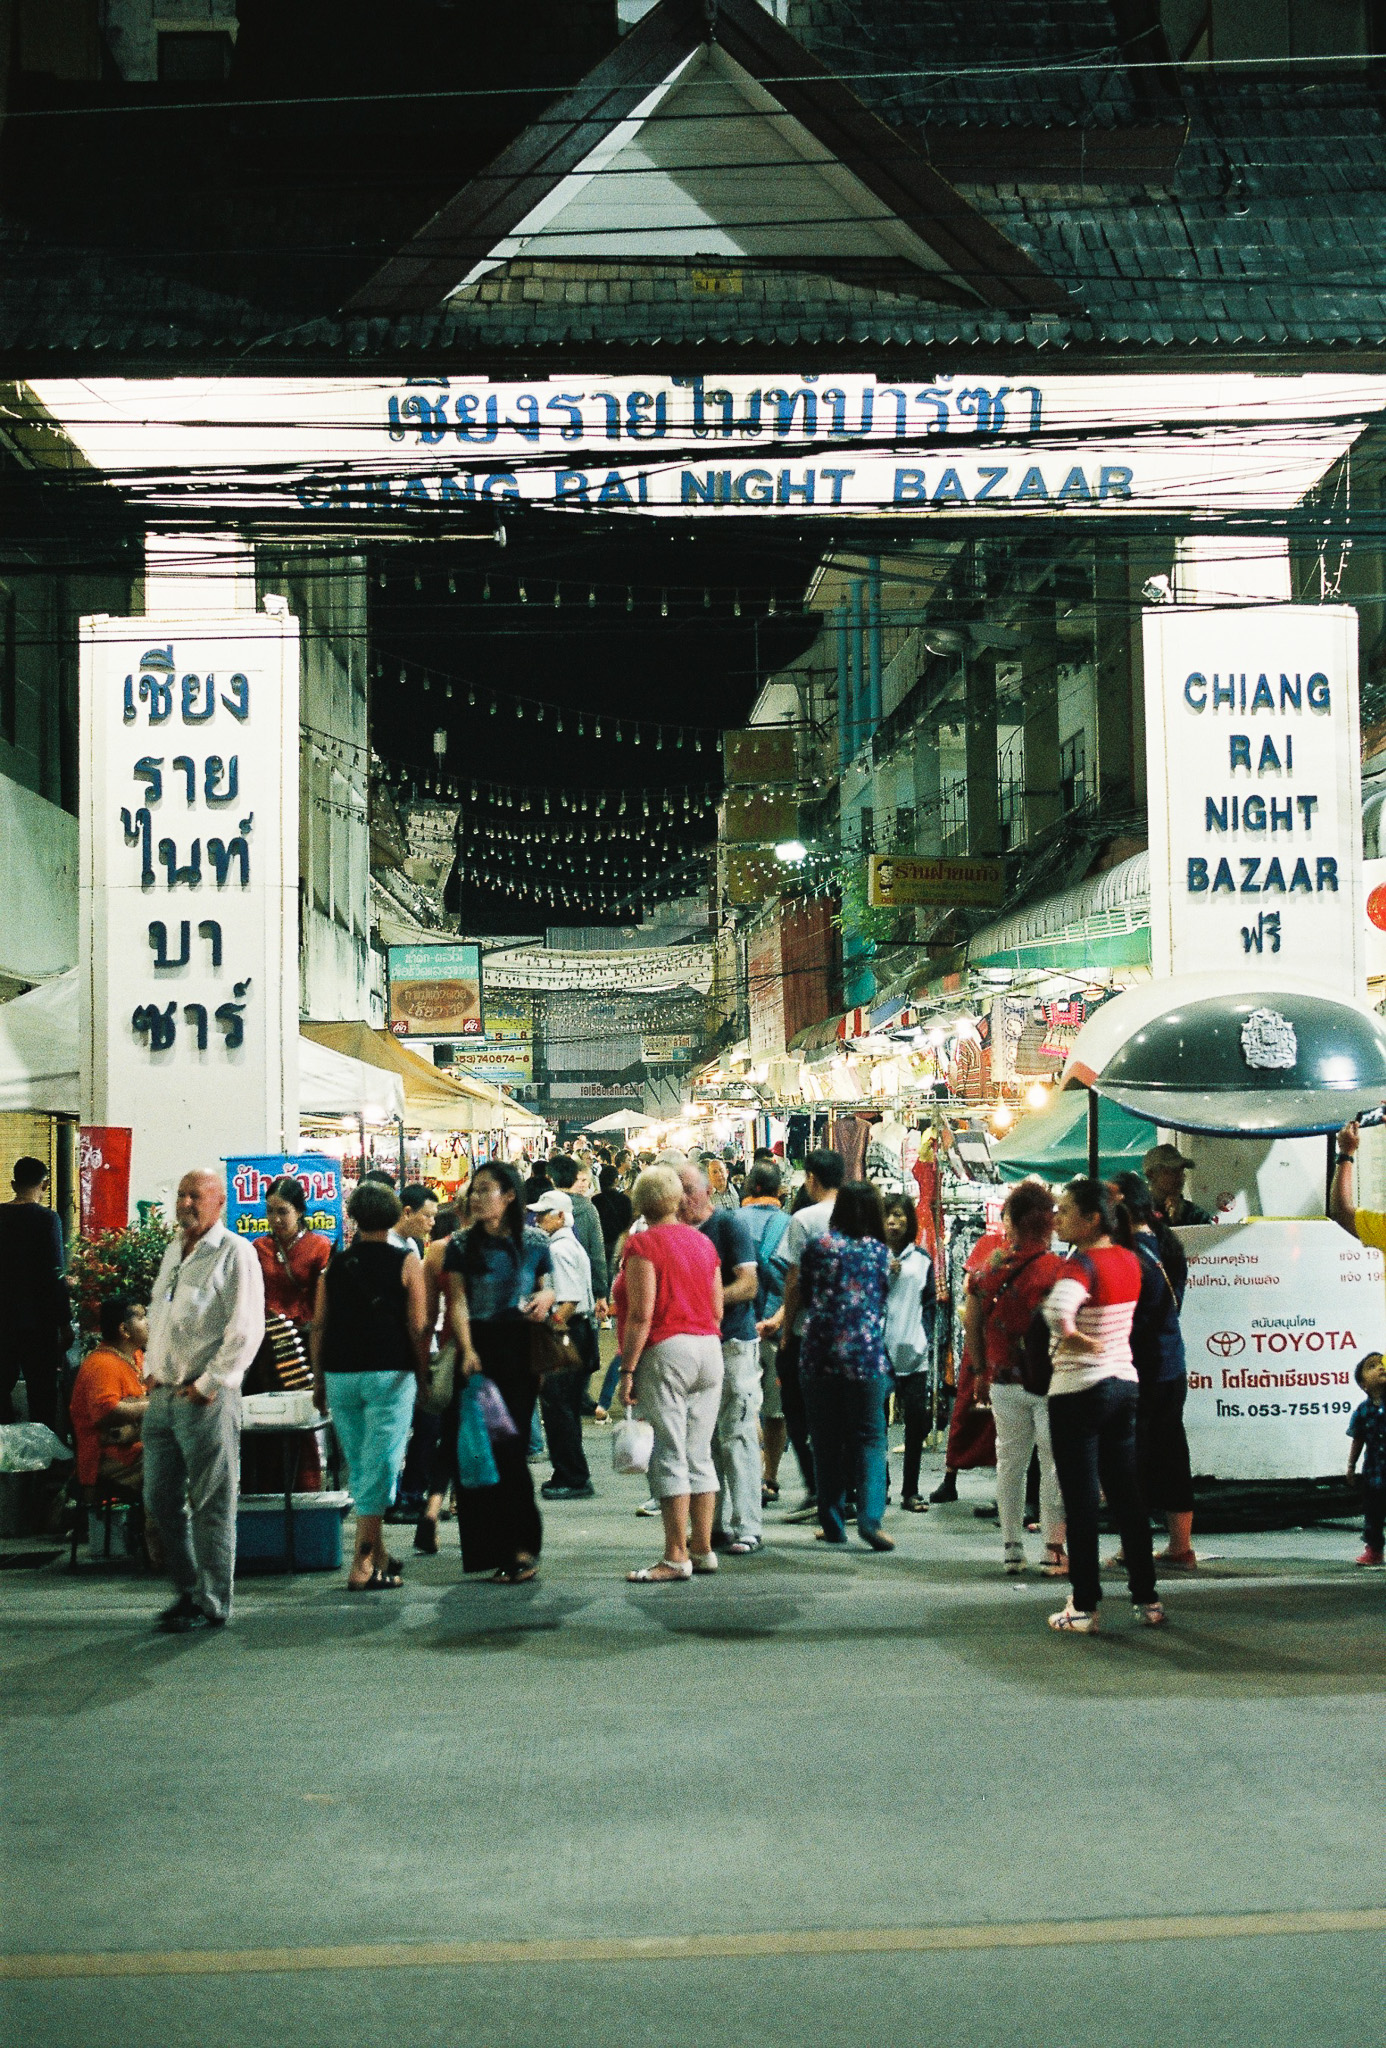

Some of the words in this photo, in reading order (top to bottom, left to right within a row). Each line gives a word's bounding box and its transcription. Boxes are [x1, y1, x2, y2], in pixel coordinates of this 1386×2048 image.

[555, 470, 650, 504] RAI
[680, 468, 856, 504] NIGHT
[894, 466, 1134, 503] BAZAAR
[122, 644, 252, 723] เชียง
[1184, 672, 1332, 711] CHIANG
[1229, 734, 1293, 772] RAI
[133, 754, 239, 805] ราย
[1205, 795, 1319, 832] NIGHT
[120, 807, 254, 887] ไนท์
[1187, 857, 1340, 893] BAZAAR
[148, 920, 223, 968] บา
[1240, 911, 1282, 954] ฟรี
[131, 978, 253, 1051] ซาร์
[1251, 1314, 1316, 1329] สนับสนุนโดย
[1251, 1331, 1358, 1353] TOYOTA
[1222, 1369, 1350, 1389] โตโยต้าเชียงราย
